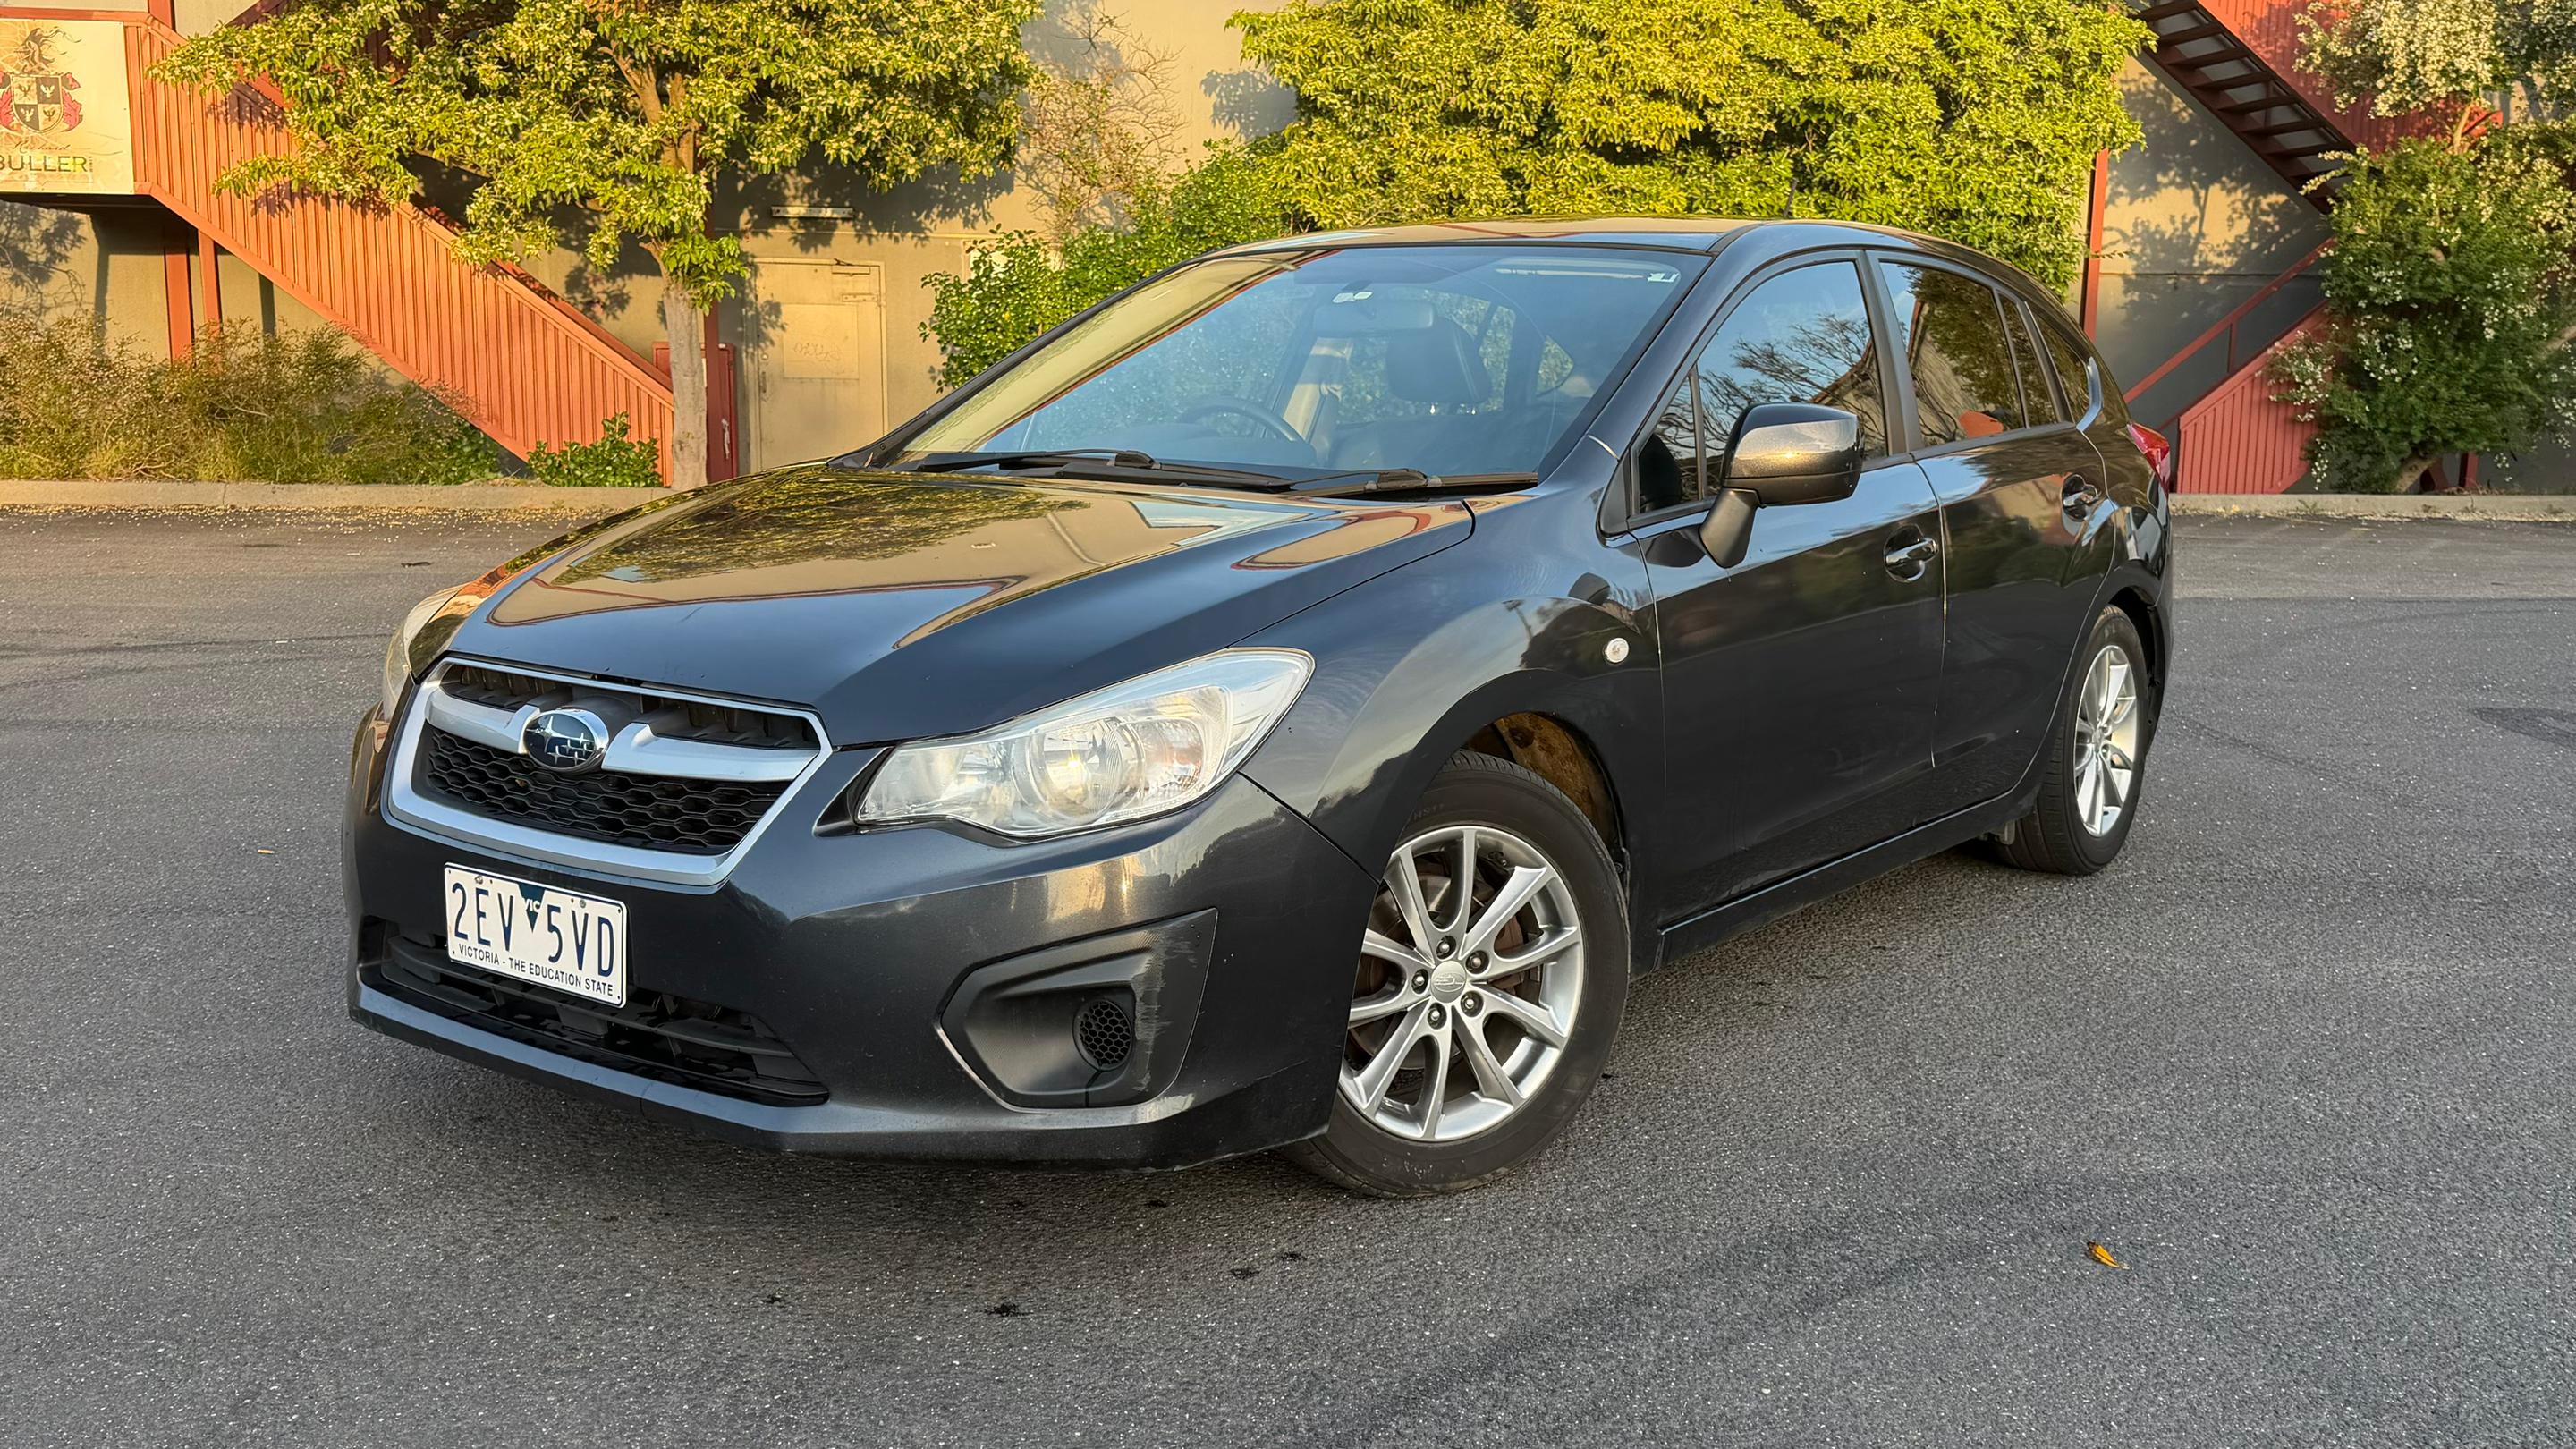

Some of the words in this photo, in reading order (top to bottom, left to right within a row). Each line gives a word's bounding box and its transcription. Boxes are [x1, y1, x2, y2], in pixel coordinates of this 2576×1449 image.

[452, 882, 514, 952] 2EV
[547, 904, 614, 977] 5VD
[459, 944, 500, 965] VICTORIA
[509, 957, 526, 973] THE
[530, 962, 581, 988] EDUCATION
[585, 978, 614, 996] STATE
